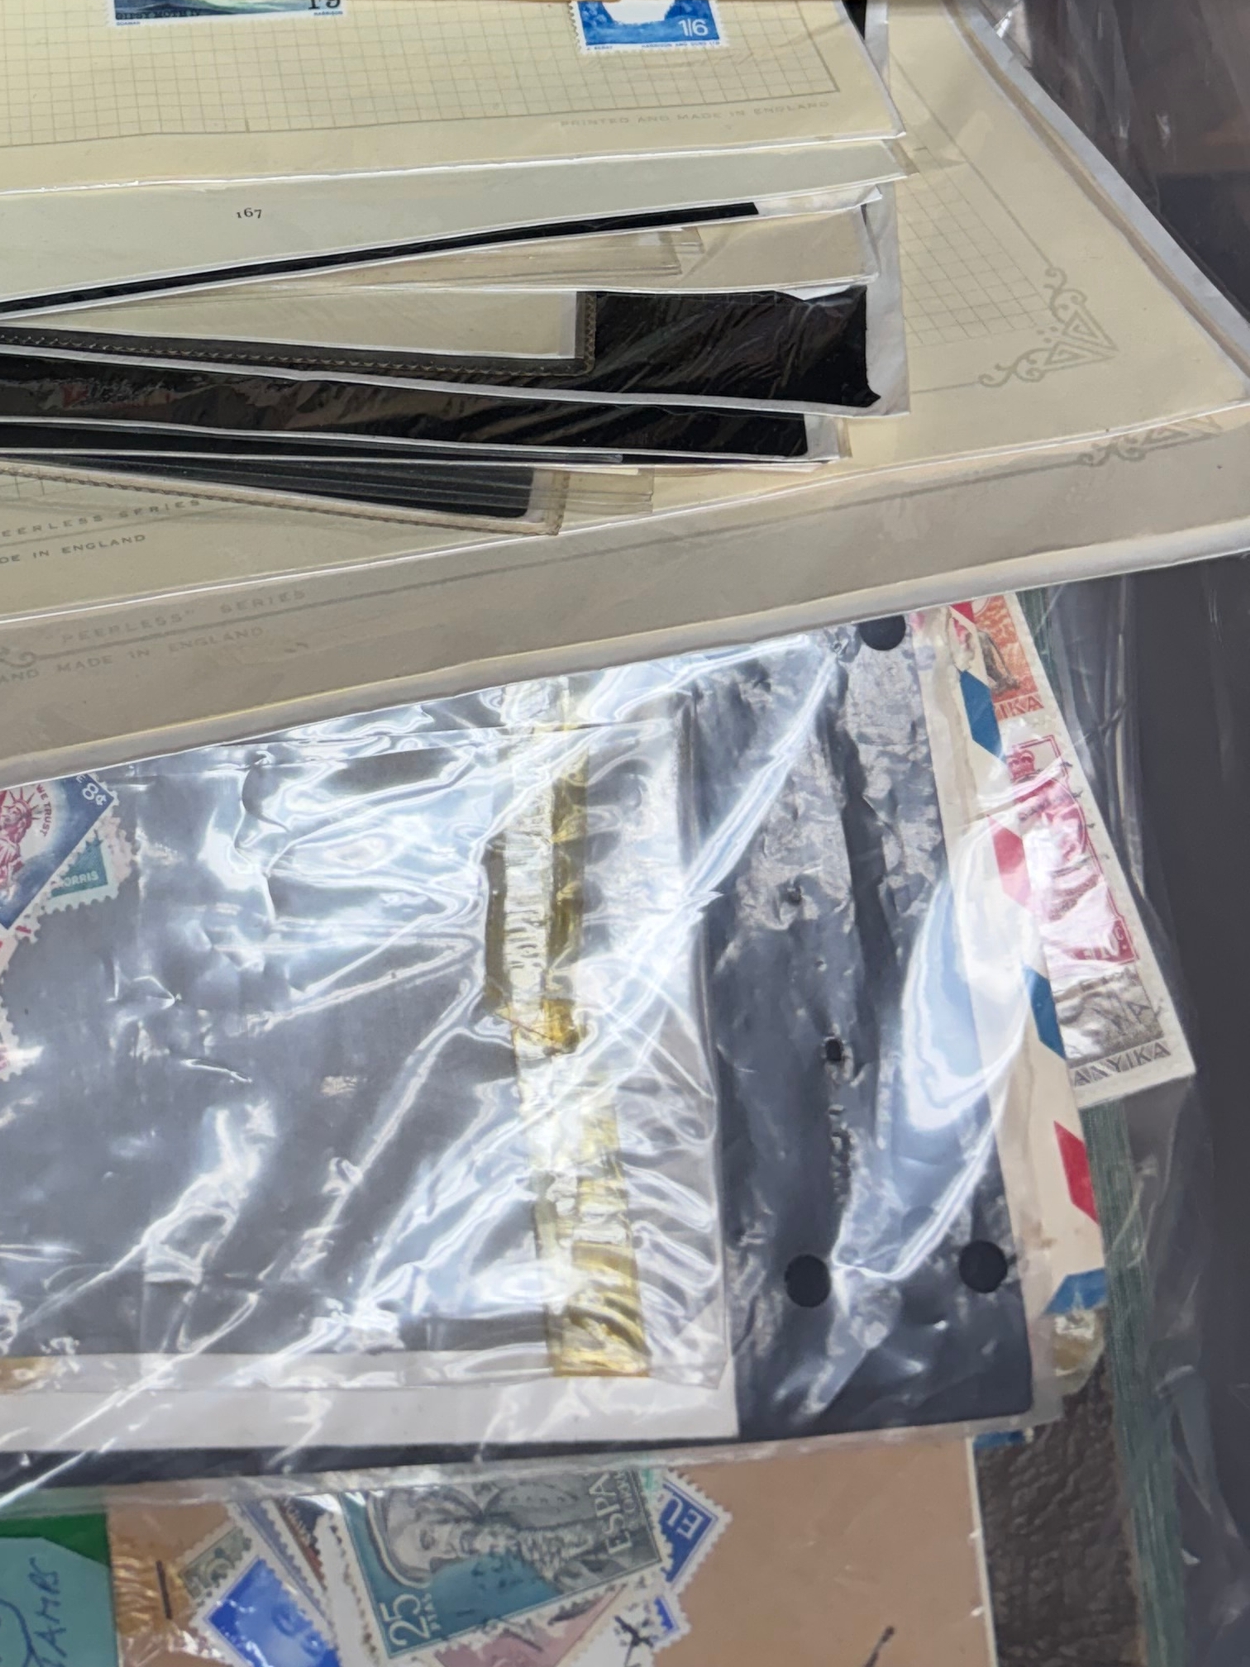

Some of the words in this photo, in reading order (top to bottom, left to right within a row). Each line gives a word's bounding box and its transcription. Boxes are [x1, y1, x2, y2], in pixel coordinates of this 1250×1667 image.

[235, 206, 262, 221] 167
[32, 548, 50, 559] IN
[61, 533, 147, 555] ENGLAND
[56, 653, 114, 674] MADE
[168, 626, 265, 653] ENGLAND
[36, 783, 50, 802] WE
[40, 801, 53, 838] TRUST
[1072, 1040, 1172, 1088] ANYIKA
[379, 1592, 434, 1647] 25
